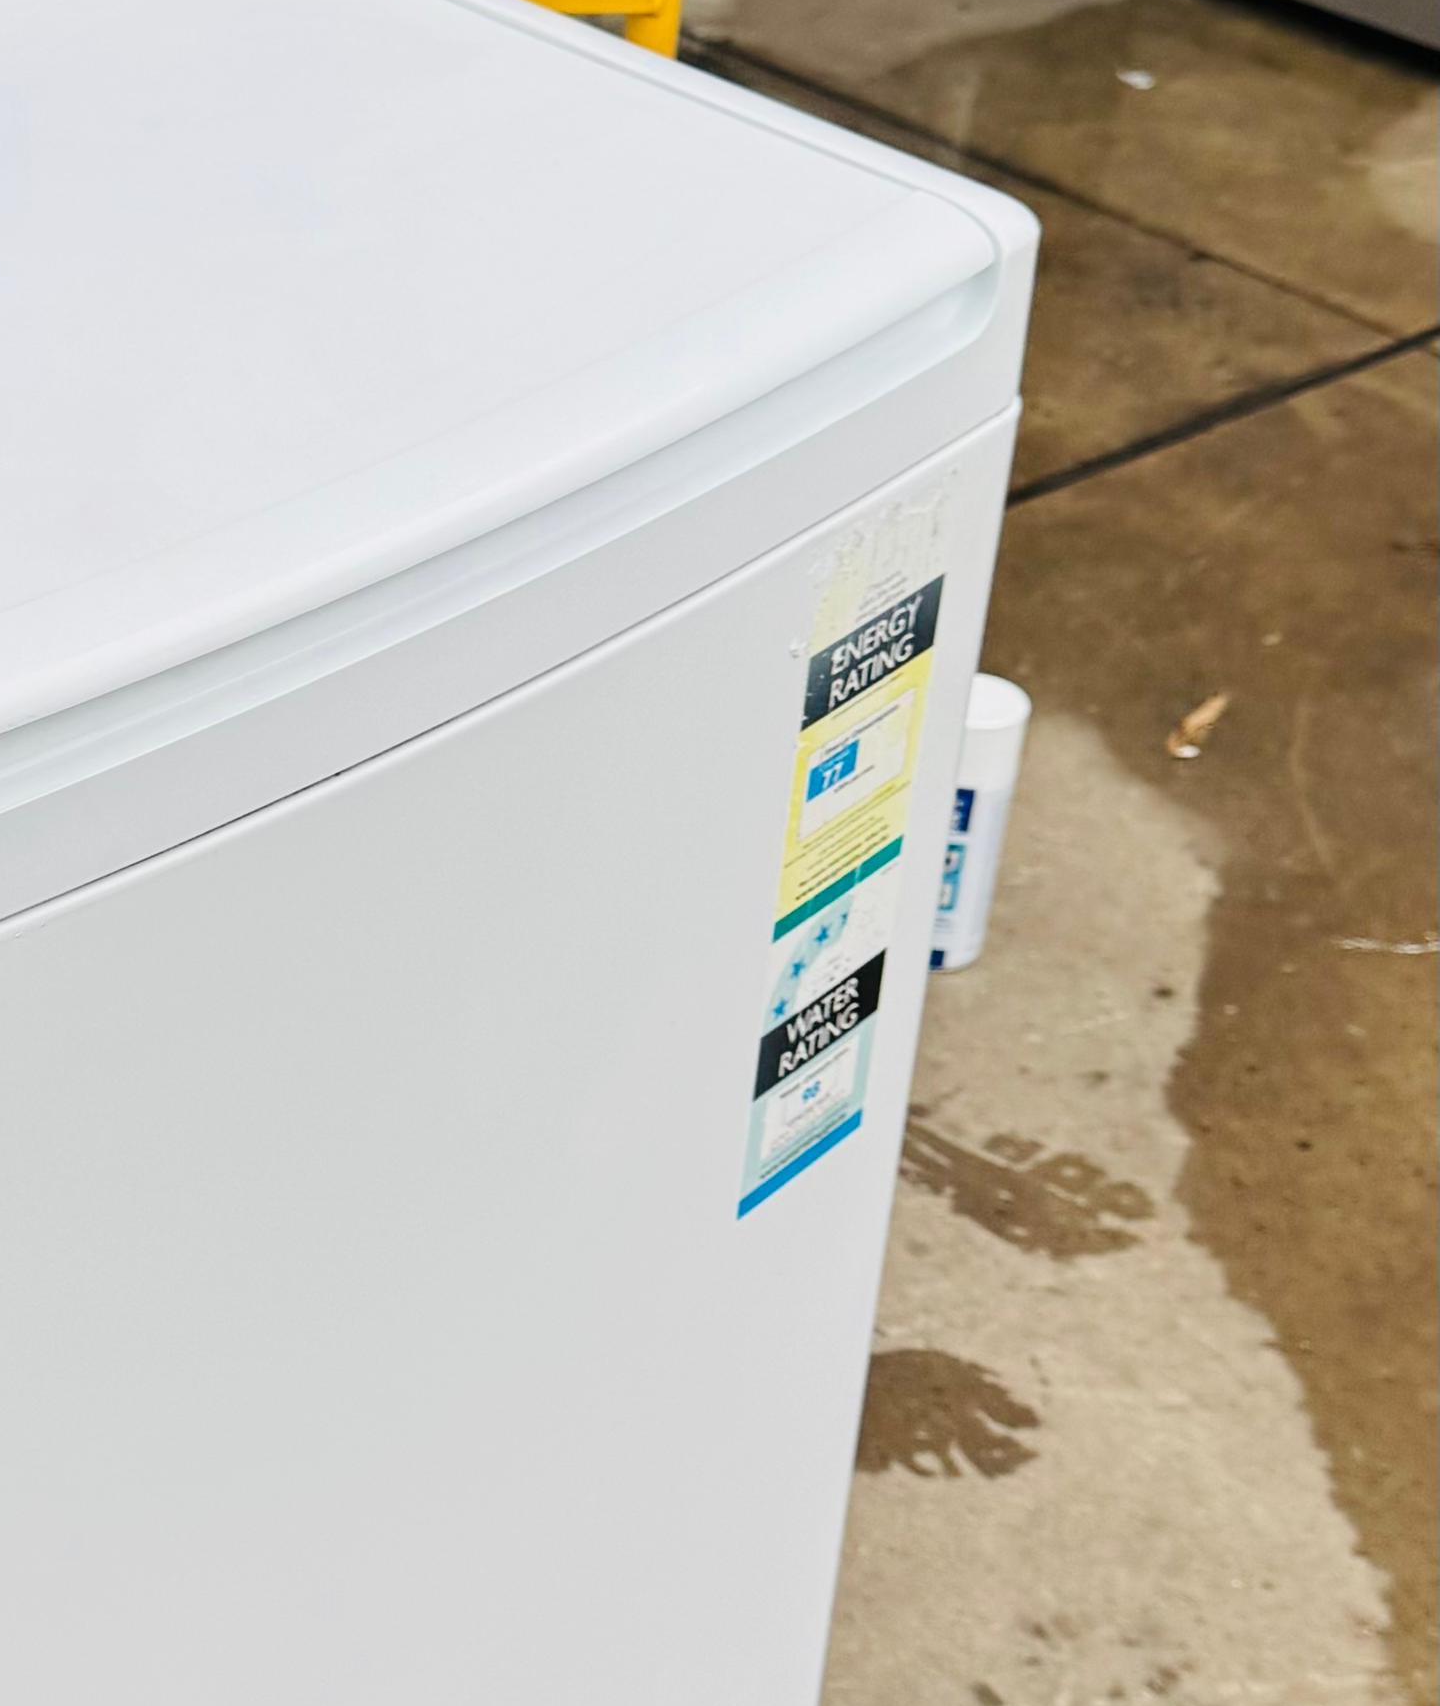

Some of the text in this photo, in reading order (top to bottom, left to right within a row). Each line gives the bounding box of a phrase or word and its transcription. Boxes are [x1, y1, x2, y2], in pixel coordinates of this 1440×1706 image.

[828, 632, 915, 713] RATING
[830, 594, 923, 676] ENERGY
[777, 1002, 860, 1078] RATING
[785, 976, 860, 1044] WATER
